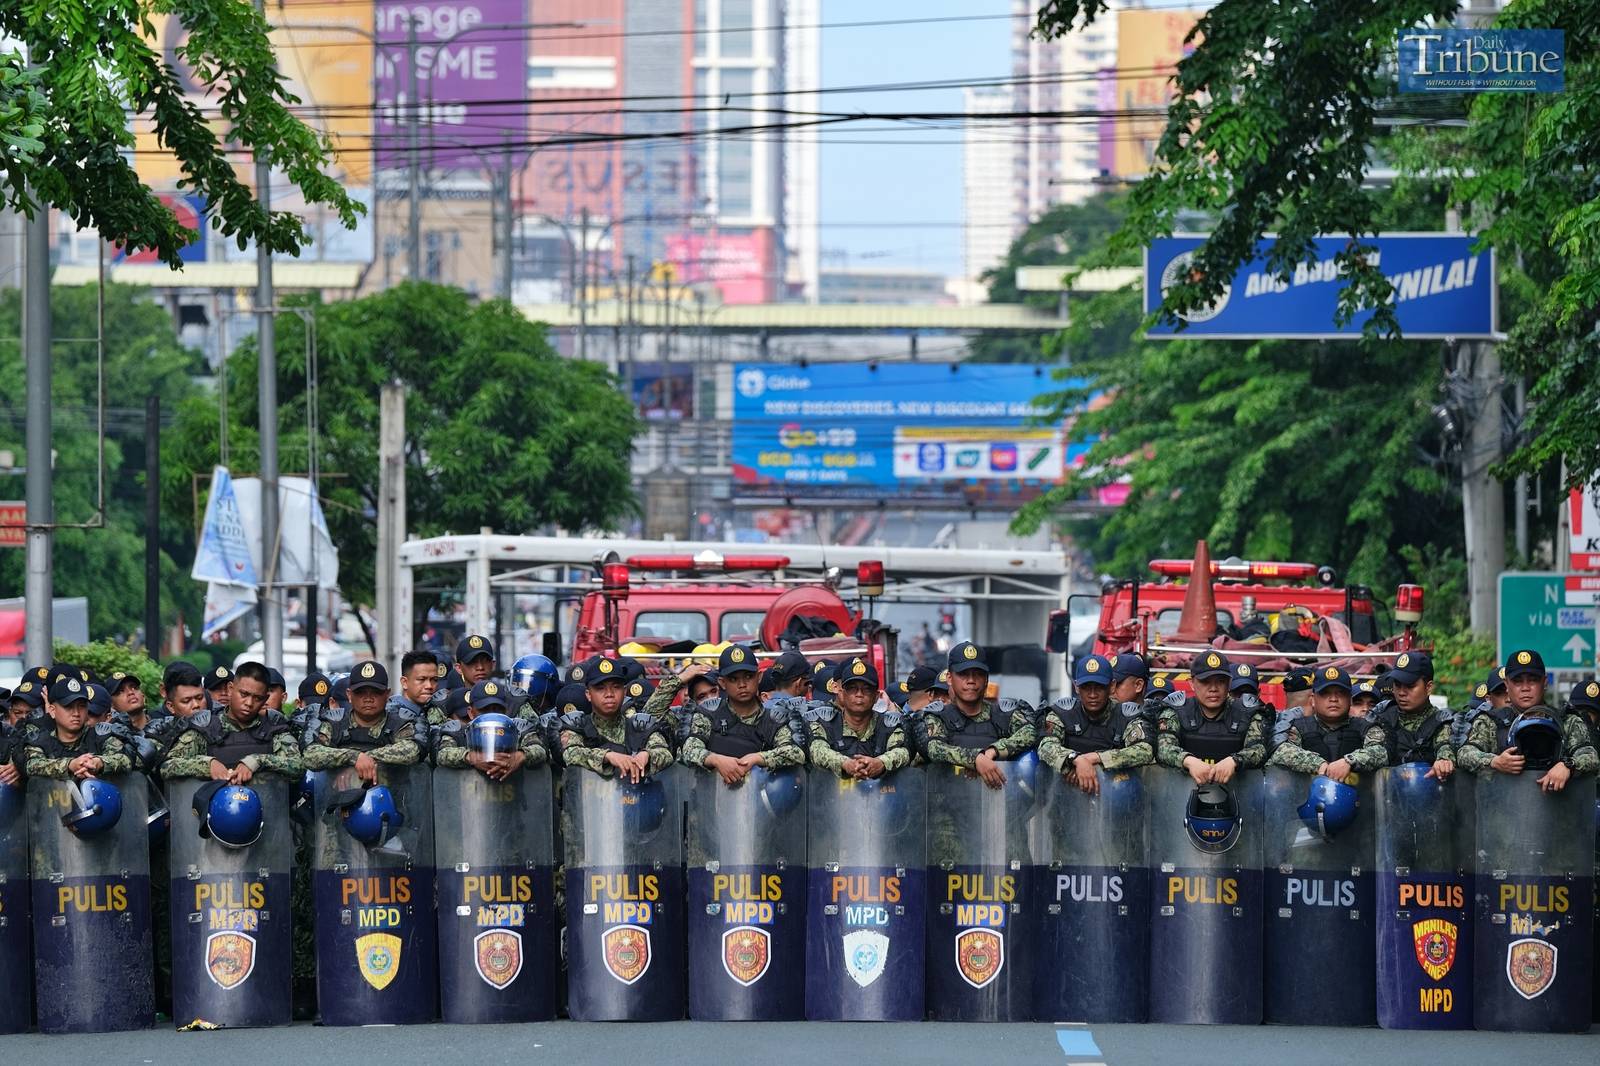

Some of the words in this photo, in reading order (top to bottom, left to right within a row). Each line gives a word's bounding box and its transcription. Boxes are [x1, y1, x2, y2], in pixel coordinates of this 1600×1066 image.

[415, 46, 497, 79] SME
[1528, 610, 1552, 626] via
[58, 885, 128, 913] PULIS
[195, 882, 265, 911] PULIS
[342, 876, 411, 904] PULIS
[464, 875, 532, 902] PULIS
[591, 875, 659, 901] PULIS
[714, 874, 782, 901] PULIS
[832, 876, 900, 902] PULIS
[948, 875, 1015, 901] PULIS
[1056, 875, 1123, 902] PULIS
[1168, 877, 1238, 905] PULIS
[1287, 878, 1355, 906] PULIS
[1400, 884, 1464, 908] PULIS
[1501, 884, 1569, 912] PULIS
[359, 908, 400, 928] MPD
[604, 903, 651, 923] MPD
[726, 902, 773, 923] MPD
[846, 904, 889, 925] MPD
[957, 905, 1004, 926] MPD
[1413, 919, 1458, 940] MANILA'S
[1424, 960, 1450, 980] FINEST
[1420, 988, 1453, 1013] MPD
